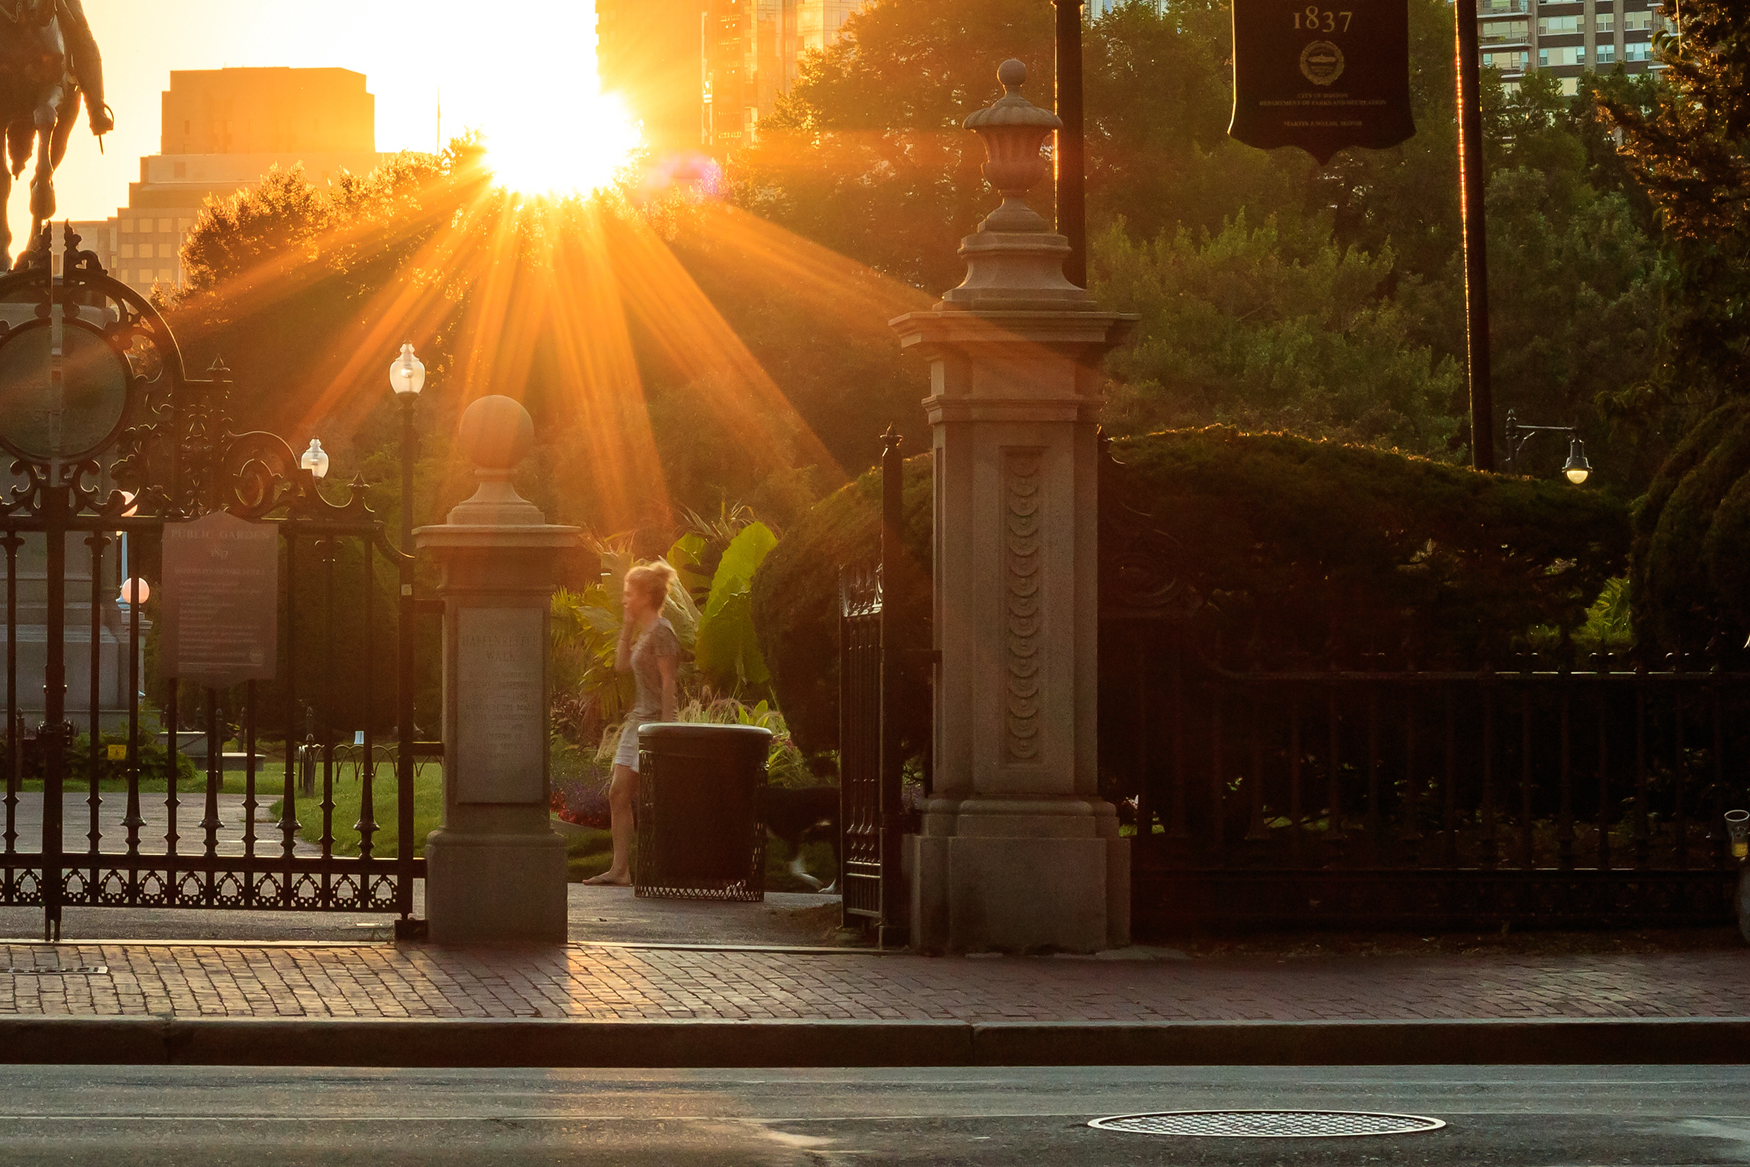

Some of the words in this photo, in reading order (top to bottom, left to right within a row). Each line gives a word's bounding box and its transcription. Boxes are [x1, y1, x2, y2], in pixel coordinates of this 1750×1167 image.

[1293, 5, 1353, 33] 1837
[171, 529, 213, 539] PUBLIC
[219, 530, 270, 540] GARDEN
[485, 650, 516, 662] WALK
